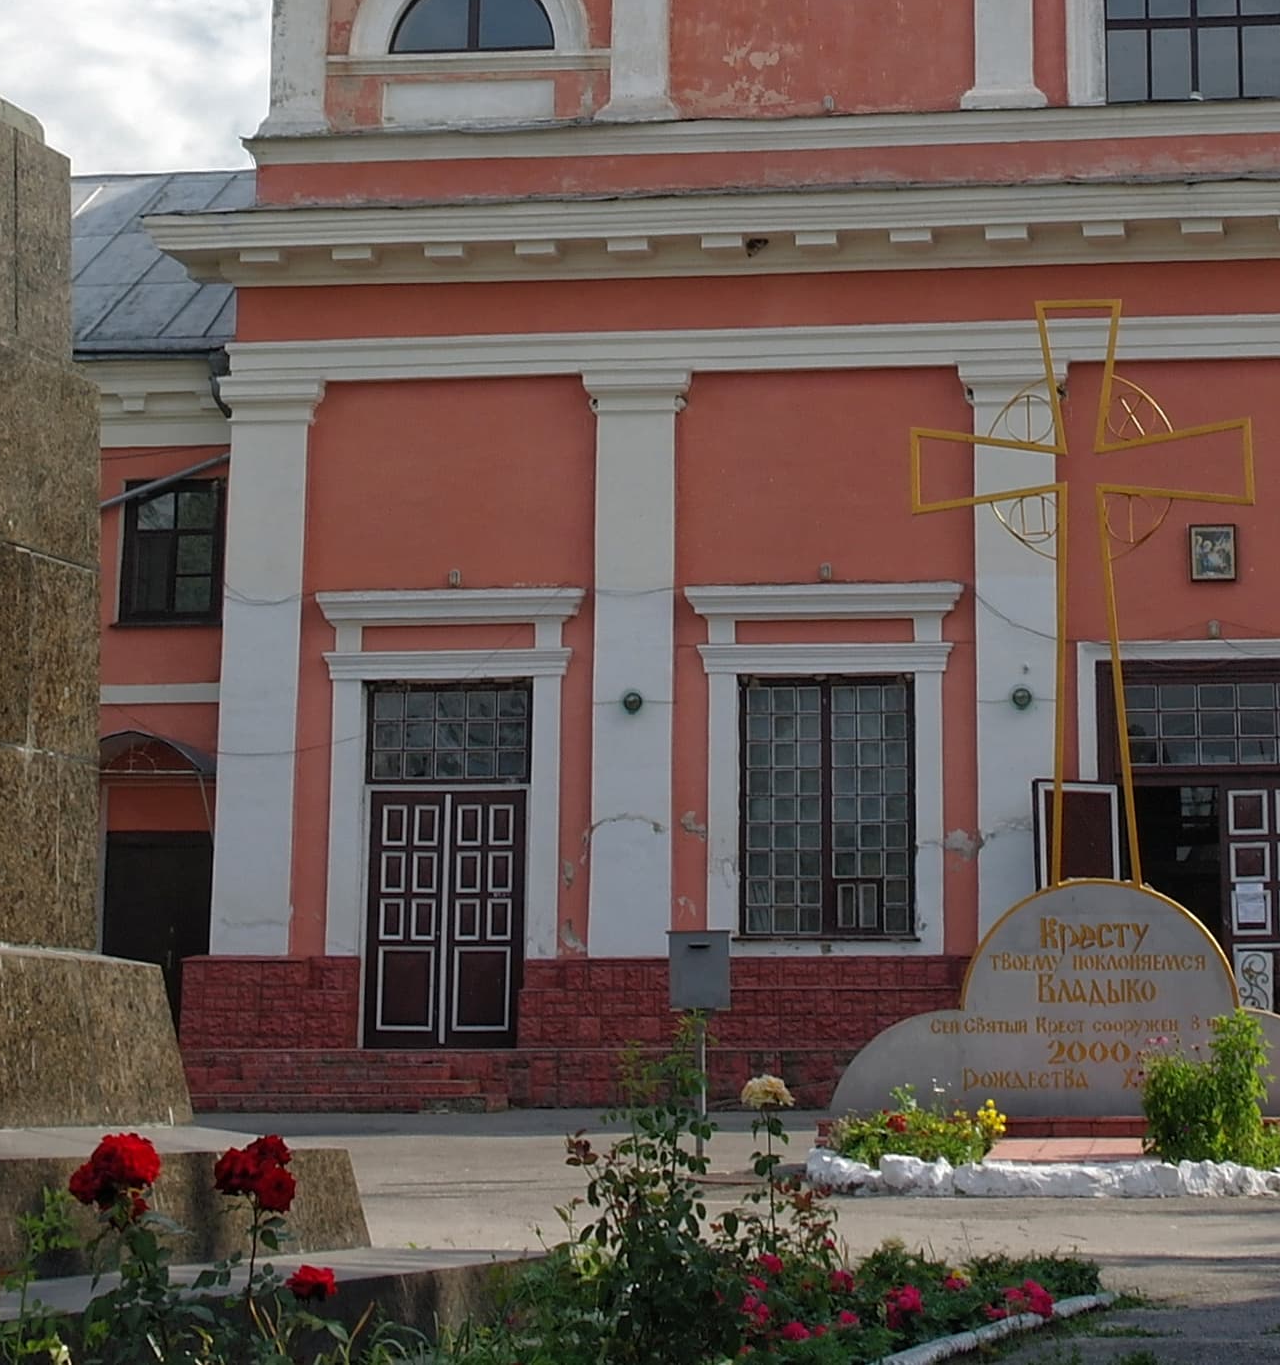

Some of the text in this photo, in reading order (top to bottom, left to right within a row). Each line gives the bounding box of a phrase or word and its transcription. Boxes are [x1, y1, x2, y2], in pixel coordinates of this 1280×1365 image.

[1039, 917, 1150, 955] Кресту
[1037, 973, 1158, 1007] Владыко
[1035, 1016, 1086, 1037] Крест
[1092, 1018, 1179, 1037] сооружен
[962, 1066, 1089, 1092] Рождества
